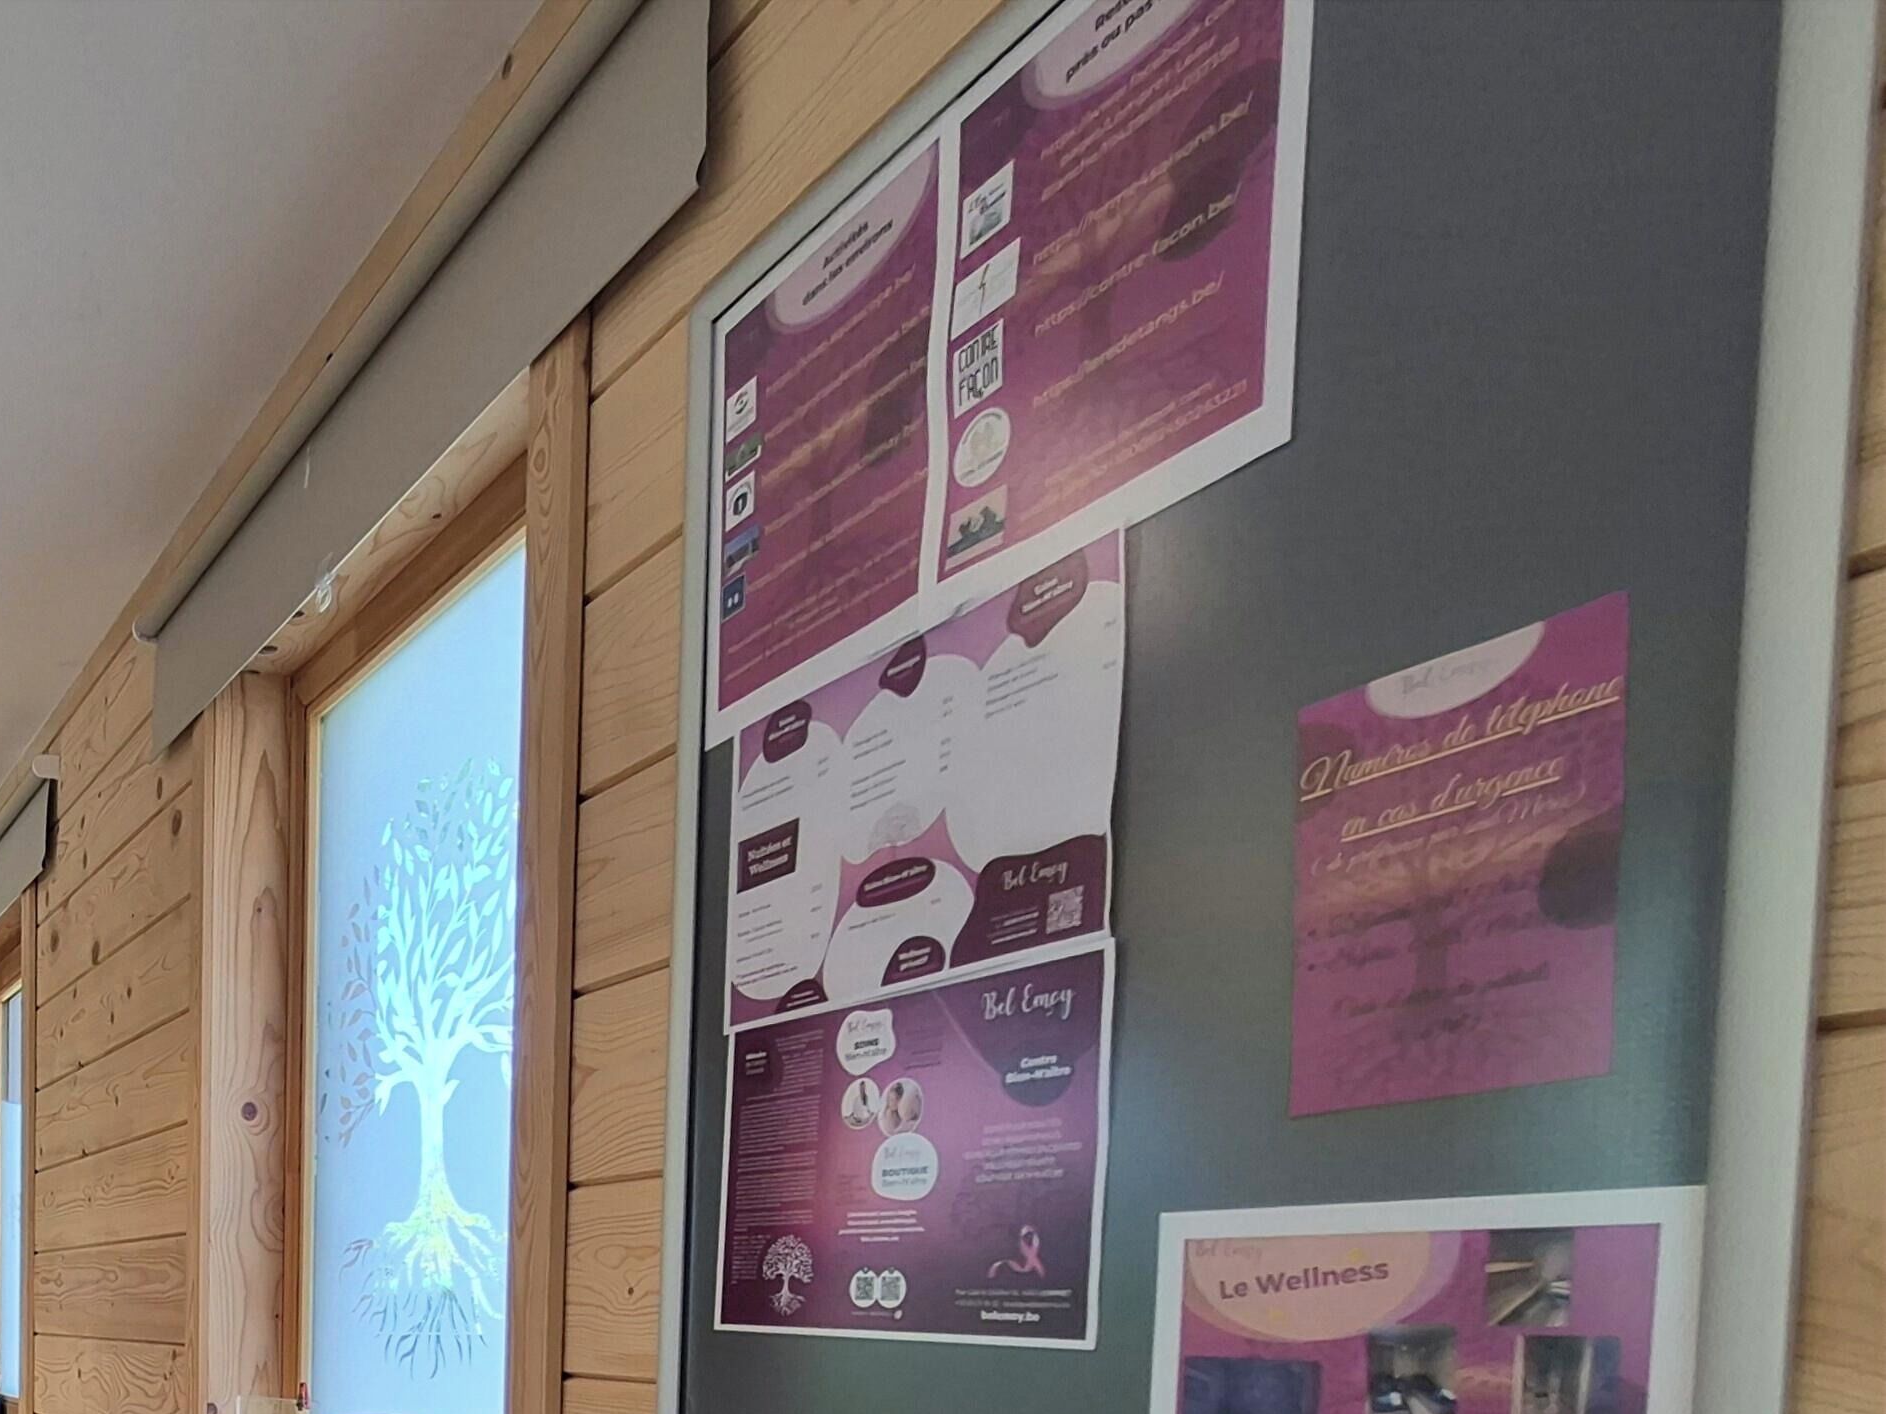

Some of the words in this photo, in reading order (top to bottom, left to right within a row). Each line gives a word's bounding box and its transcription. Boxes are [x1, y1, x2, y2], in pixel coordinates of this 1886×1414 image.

[1066, 45, 1099, 83] près
[1101, 22, 1121, 48] ou
[802, 276, 829, 306] dans
[829, 261, 844, 282] les
[845, 218, 893, 268] environs
[822, 221, 869, 270] Activités
[1300, 741, 1432, 790] Numéros
[1442, 714, 1474, 750] de
[1485, 673, 1625, 735] téléphone
[1341, 817, 1366, 836] en
[1378, 805, 1418, 825] cas
[1432, 757, 1564, 810] d'urgence
[1001, 865, 1029, 891] Bel
[980, 988, 1016, 1020] Bel
[1020, 1053, 1057, 1069] Centre
[881, 1164, 929, 1178] BOUTIQUE
[1219, 1280, 1248, 1300] Le
[1255, 1262, 1390, 1295] Wellness
